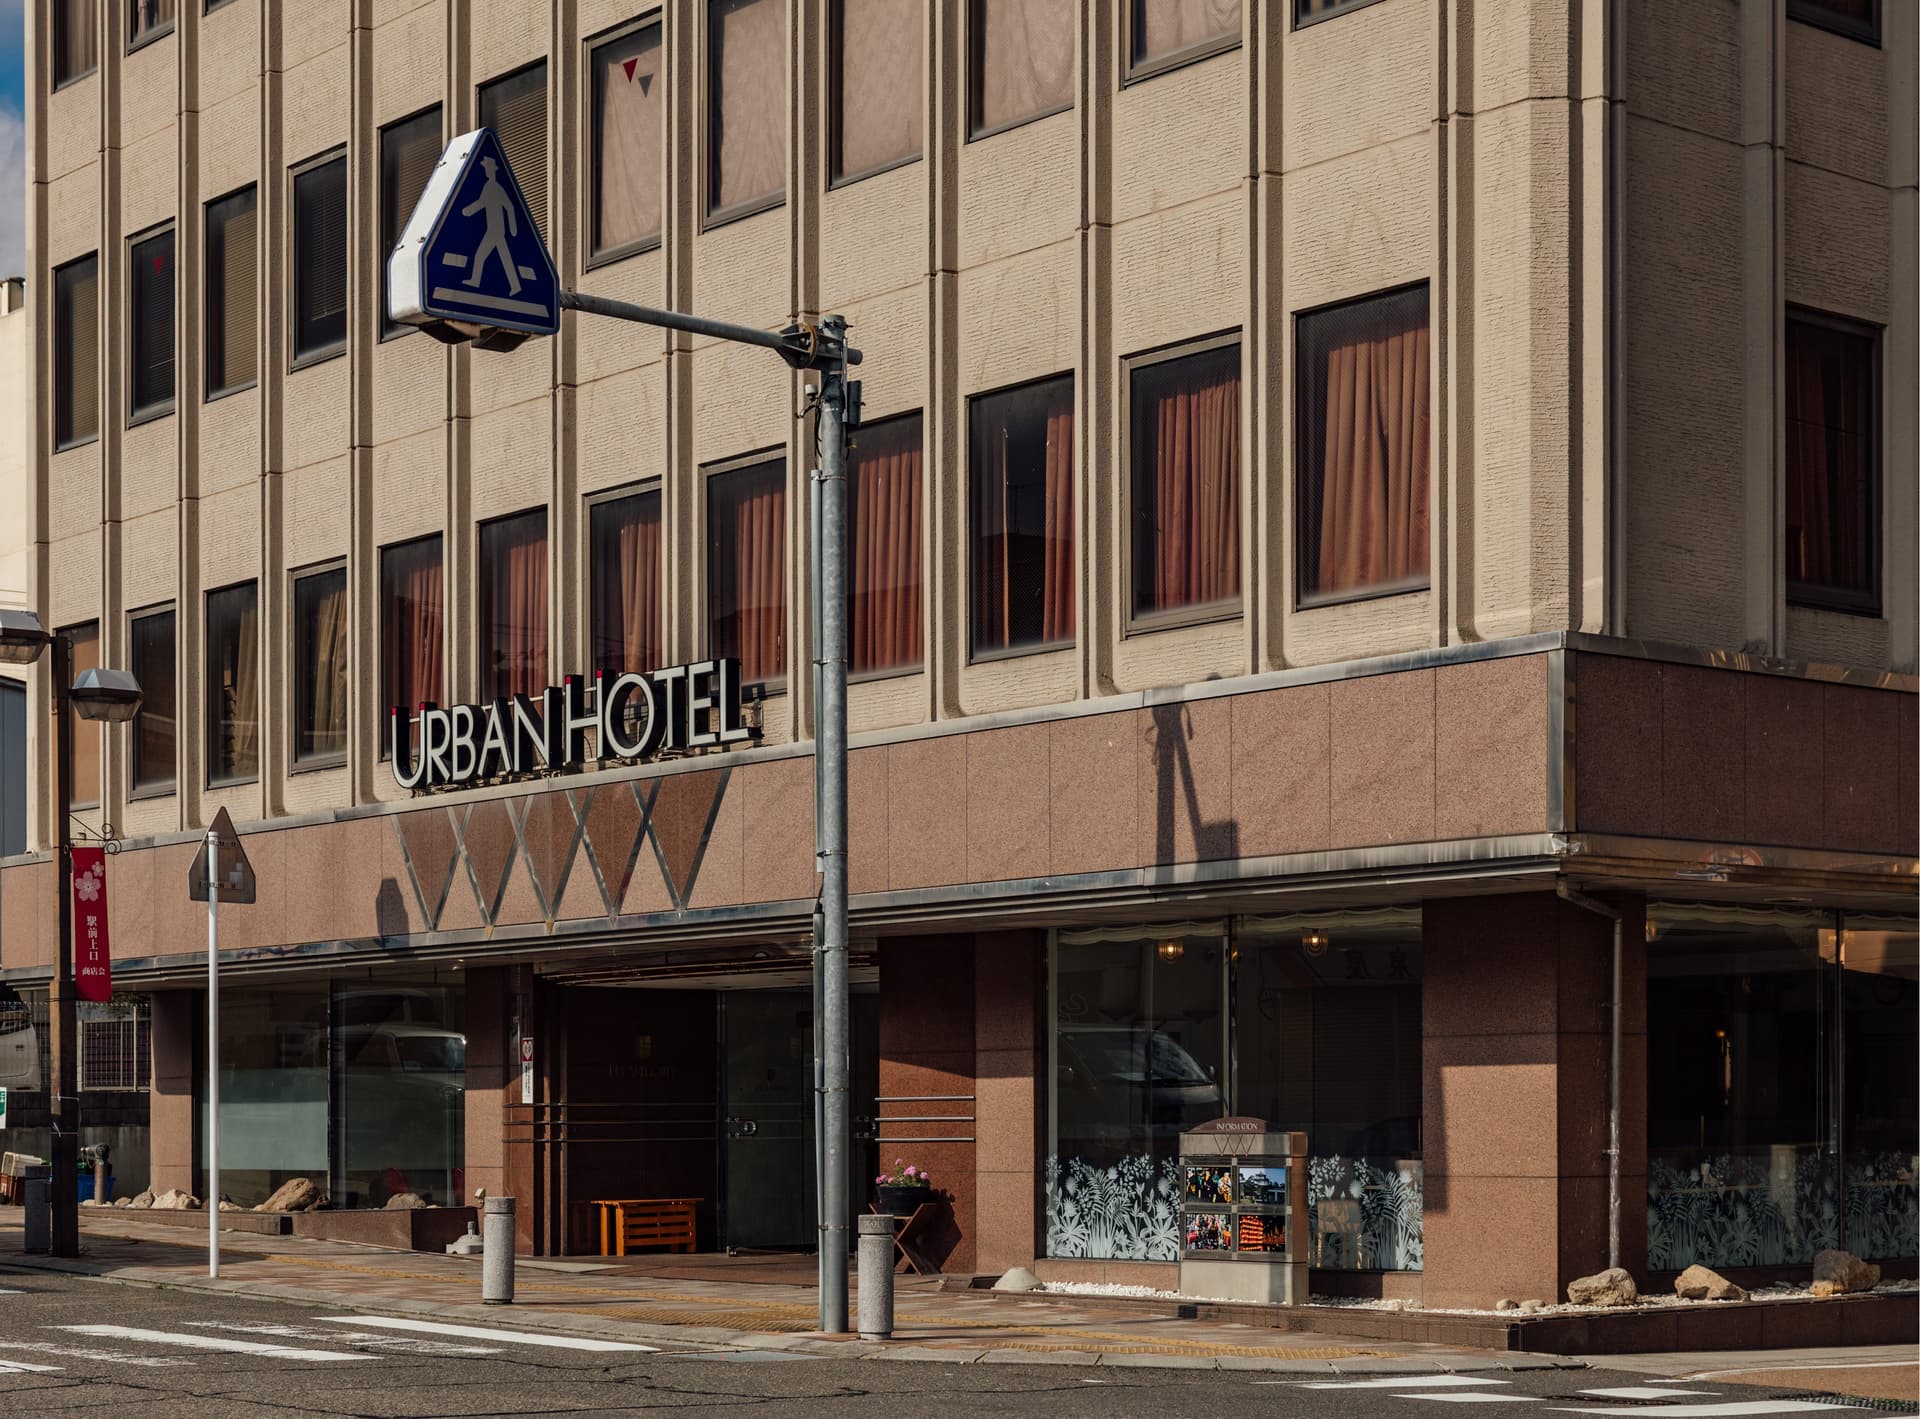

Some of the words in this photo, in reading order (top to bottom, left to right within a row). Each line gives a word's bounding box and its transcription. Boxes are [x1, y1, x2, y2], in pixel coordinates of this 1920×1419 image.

[391, 686, 552, 789] URBAN
[565, 658, 750, 763] HOTEL
[86, 915, 98, 961] 駅前上口
[82, 967, 106, 976] 商店会
